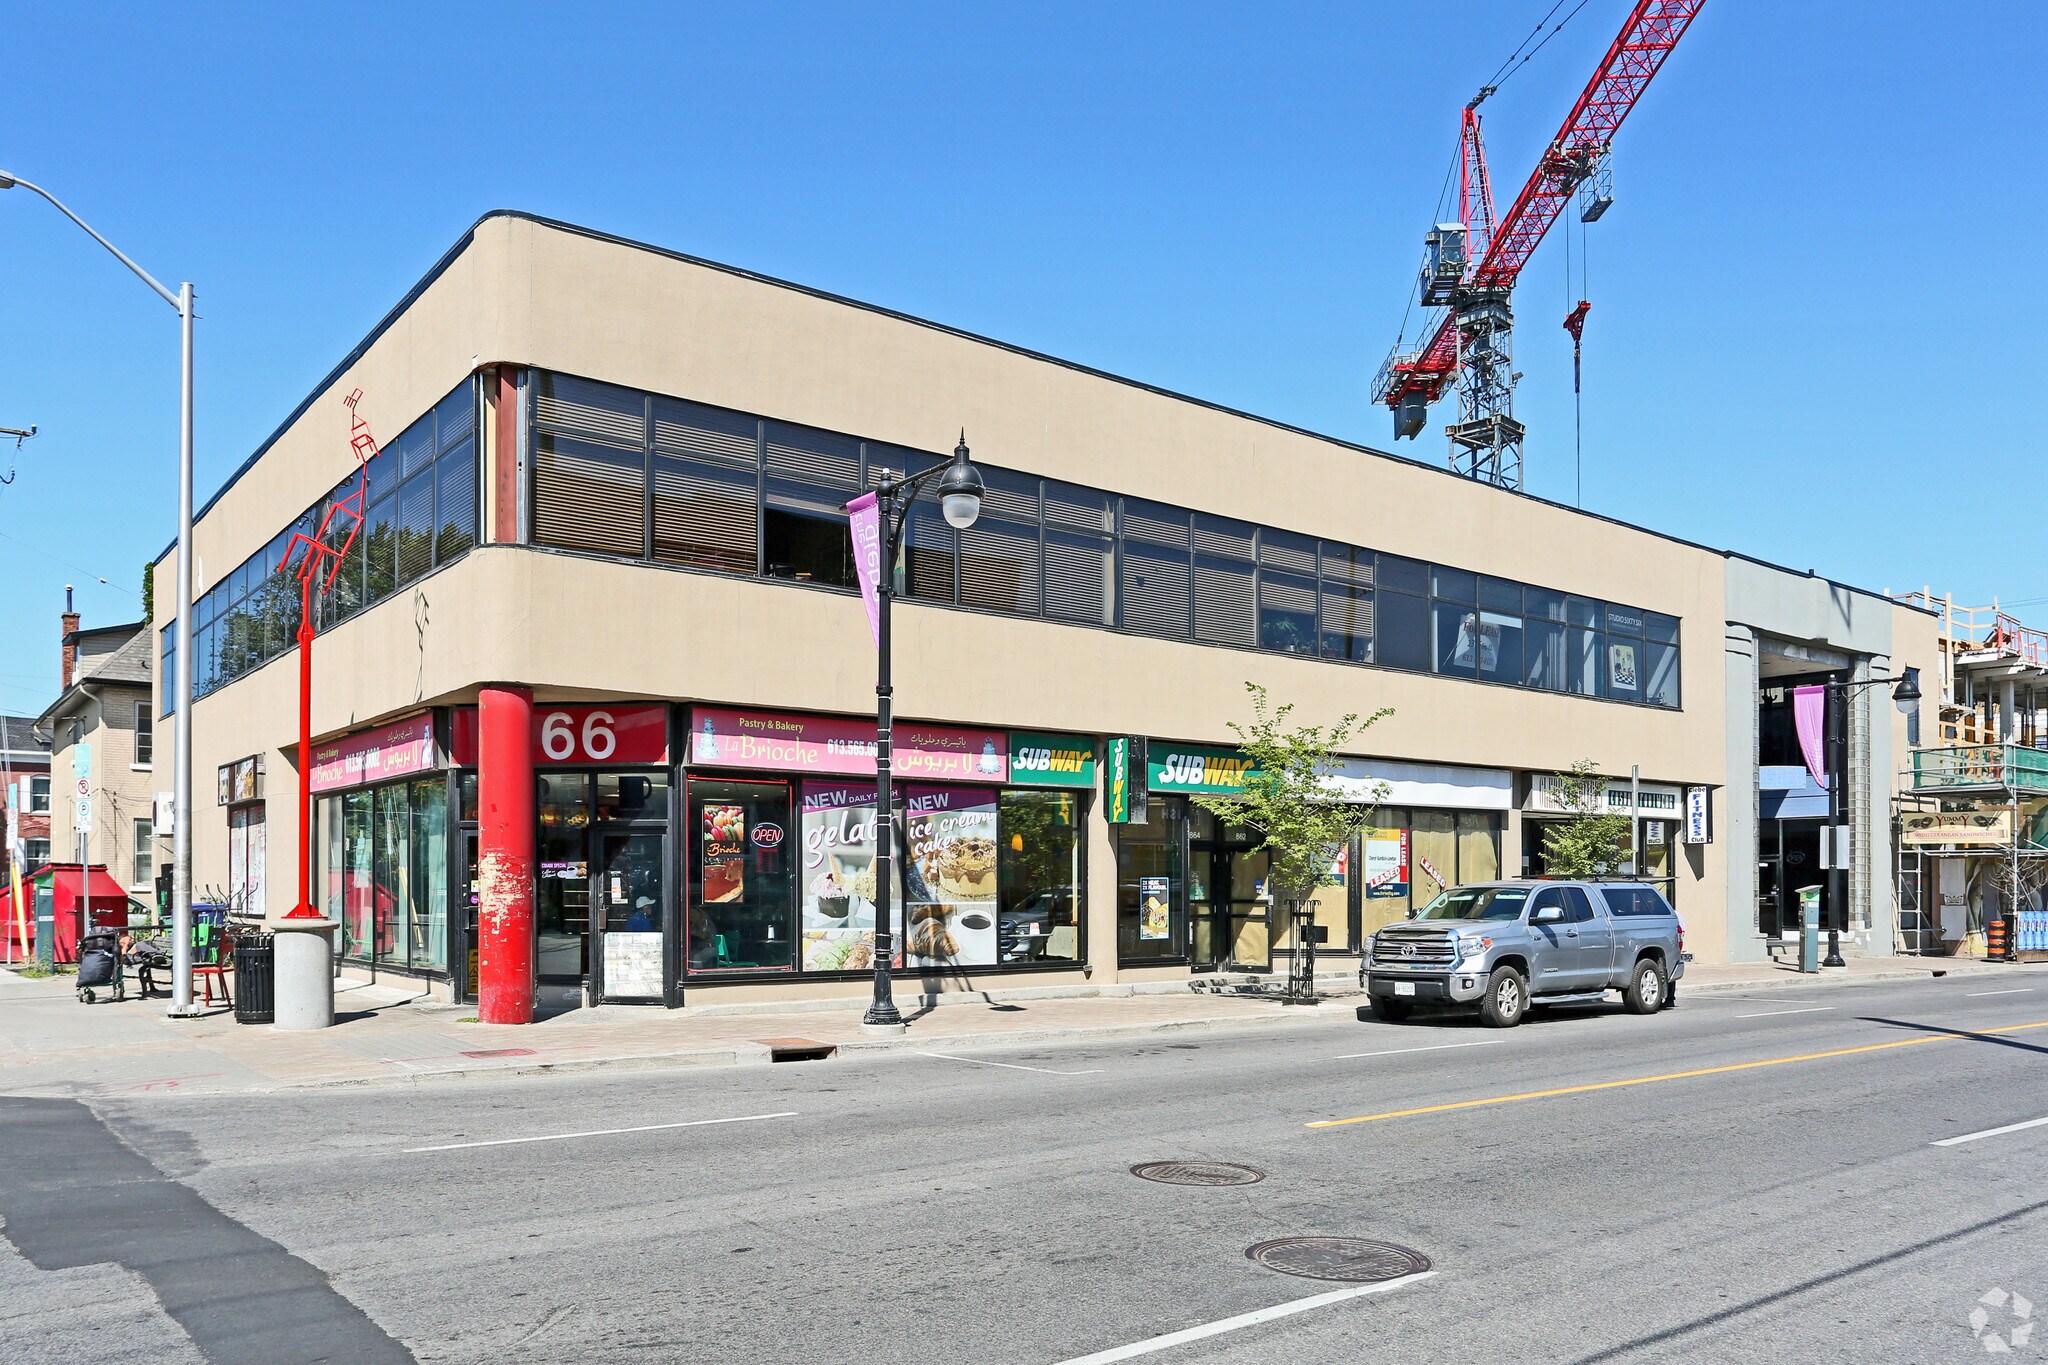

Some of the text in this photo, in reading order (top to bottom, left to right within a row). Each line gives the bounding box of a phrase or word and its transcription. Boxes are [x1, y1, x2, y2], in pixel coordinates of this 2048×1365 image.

[1608, 613, 1624, 624] STUDIO
[541, 710, 616, 761] 66
[739, 717, 804, 734] Pastry & Bakery
[725, 733, 818, 765] La Brioche
[898, 746, 958, 773] بريوش
[1012, 747, 1092, 773] SUBWAY
[317, 757, 343, 784] Brioche
[1113, 738, 1124, 822] SUBWAY
[1158, 754, 1255, 787] SUBWAY
[804, 789, 847, 810] NEW
[849, 793, 871, 803] DAILY
[909, 792, 949, 813] NEW
[909, 811, 993, 840] ice cream
[1692, 793, 1703, 837] FITNESS
[1935, 814, 1970, 829] YUMMY
[753, 829, 781, 842] OPEN
[805, 810, 878, 870] gelat
[1370, 866, 1401, 888] LEASED
[1421, 857, 1446, 888] LEASED
